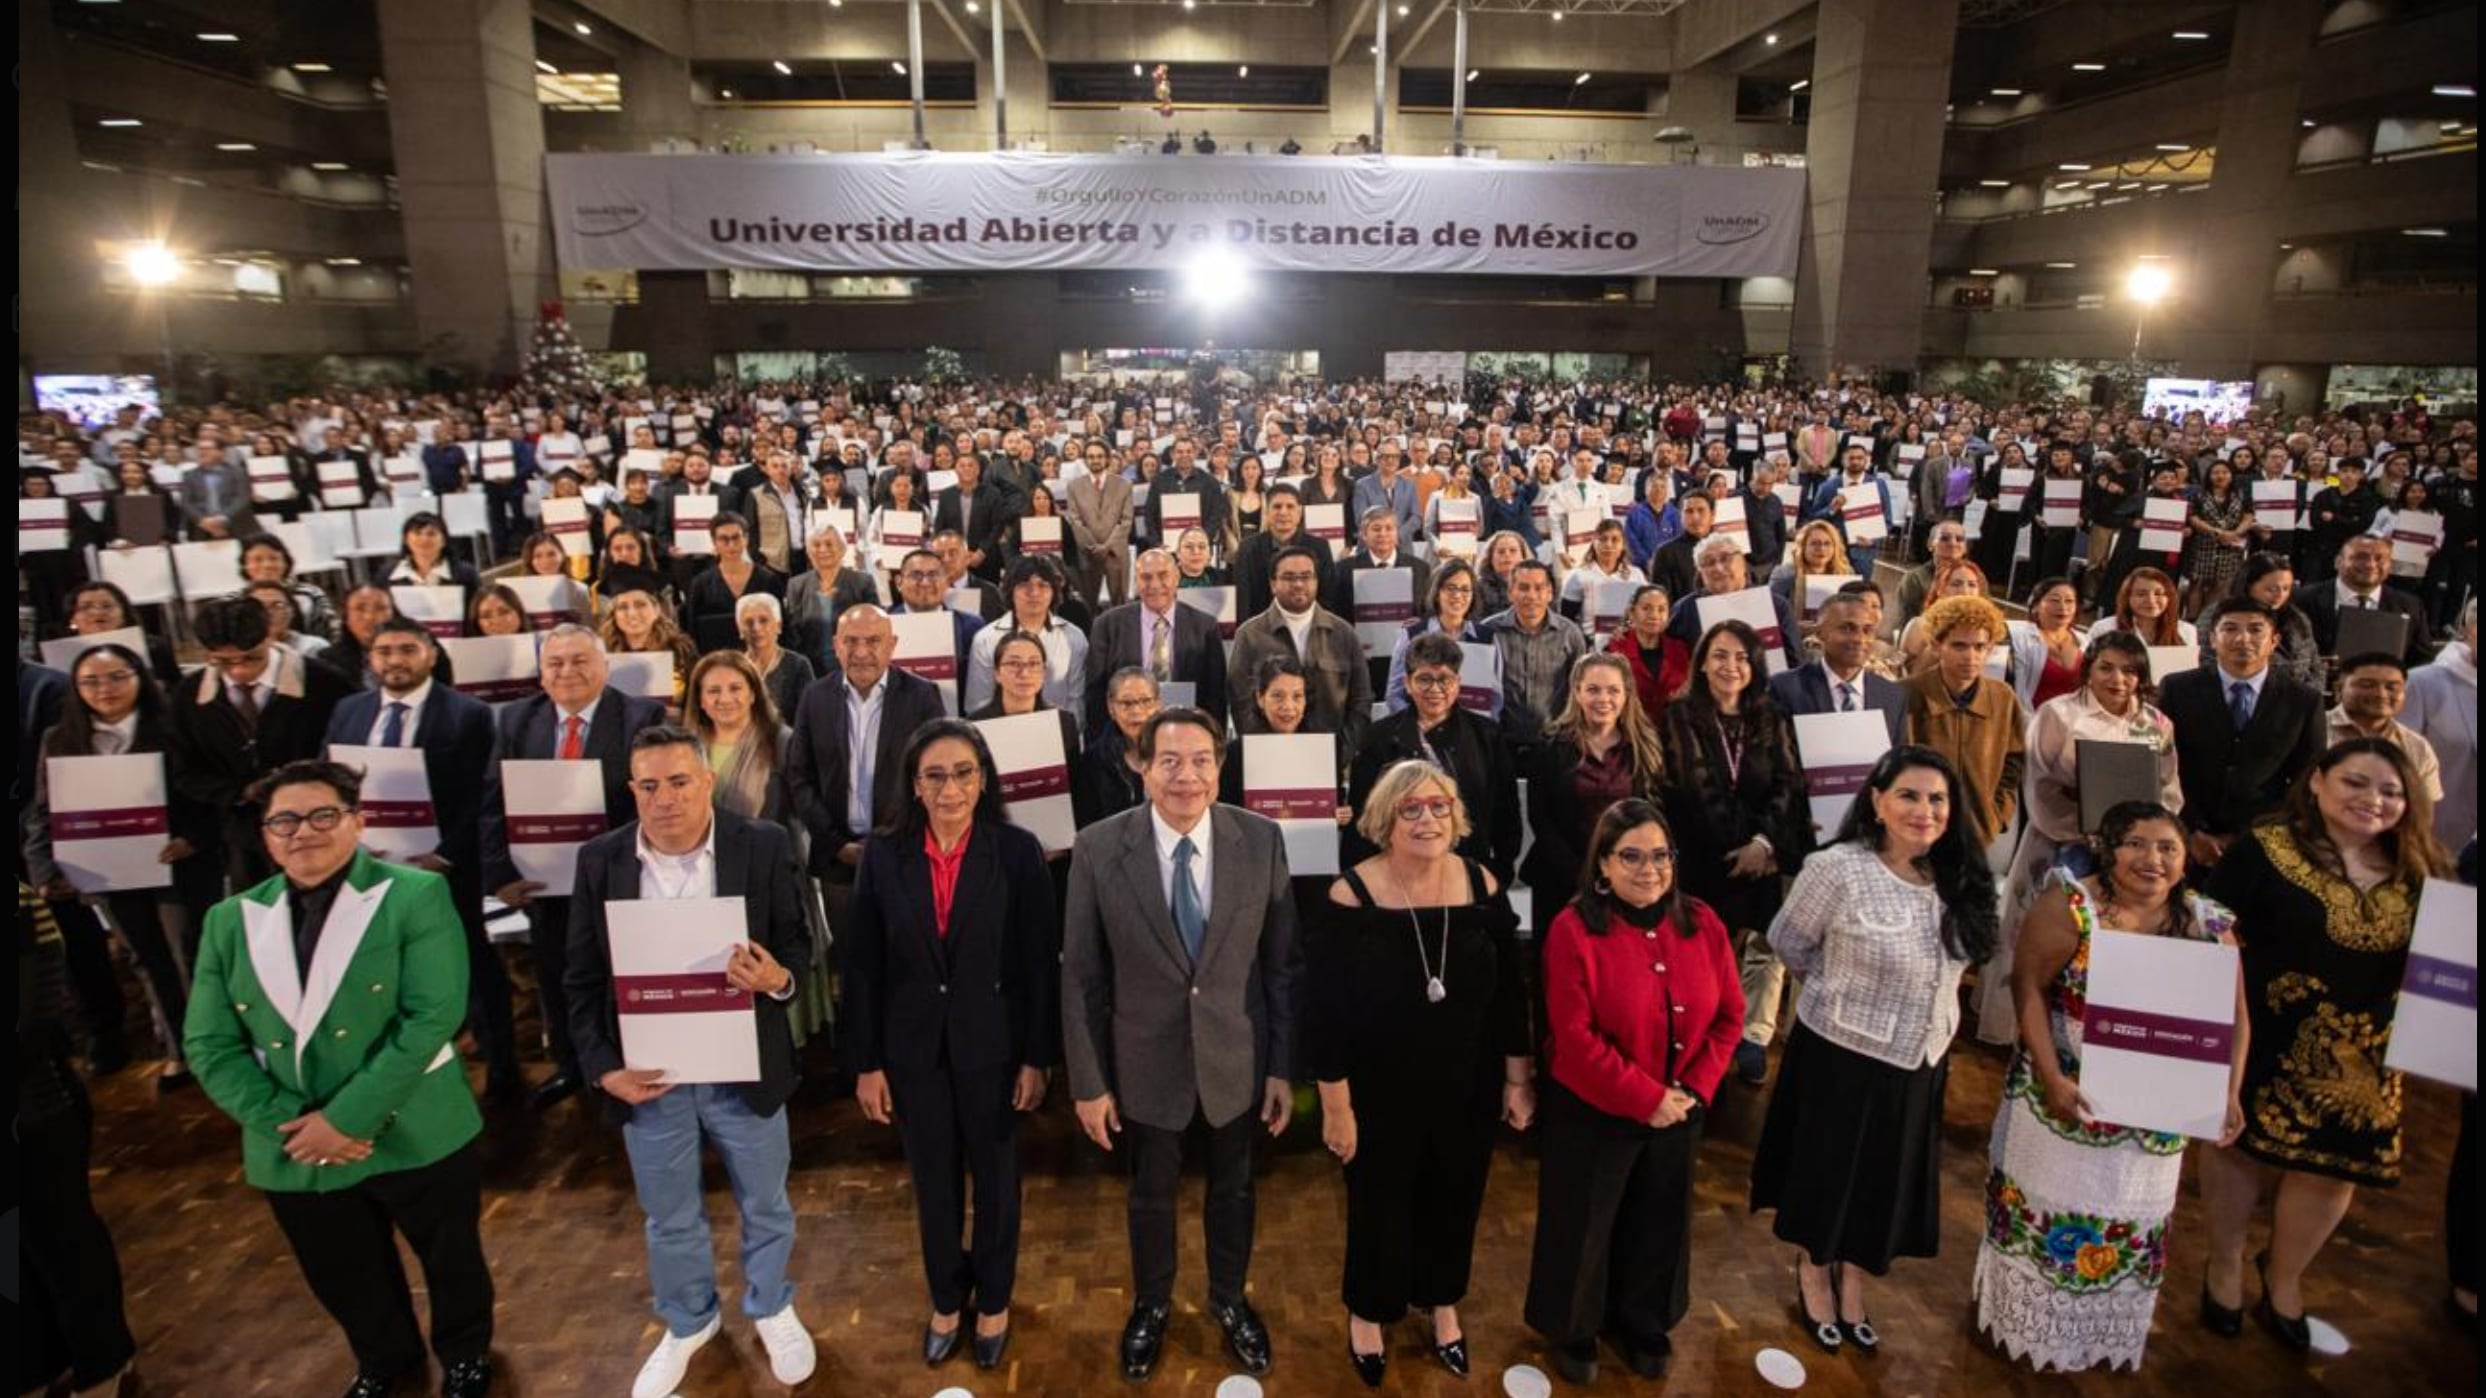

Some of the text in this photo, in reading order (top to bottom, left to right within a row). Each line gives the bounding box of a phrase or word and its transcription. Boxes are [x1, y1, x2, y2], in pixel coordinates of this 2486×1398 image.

[709, 217, 1639, 250] Universidad Abierta y a Distancia de México
